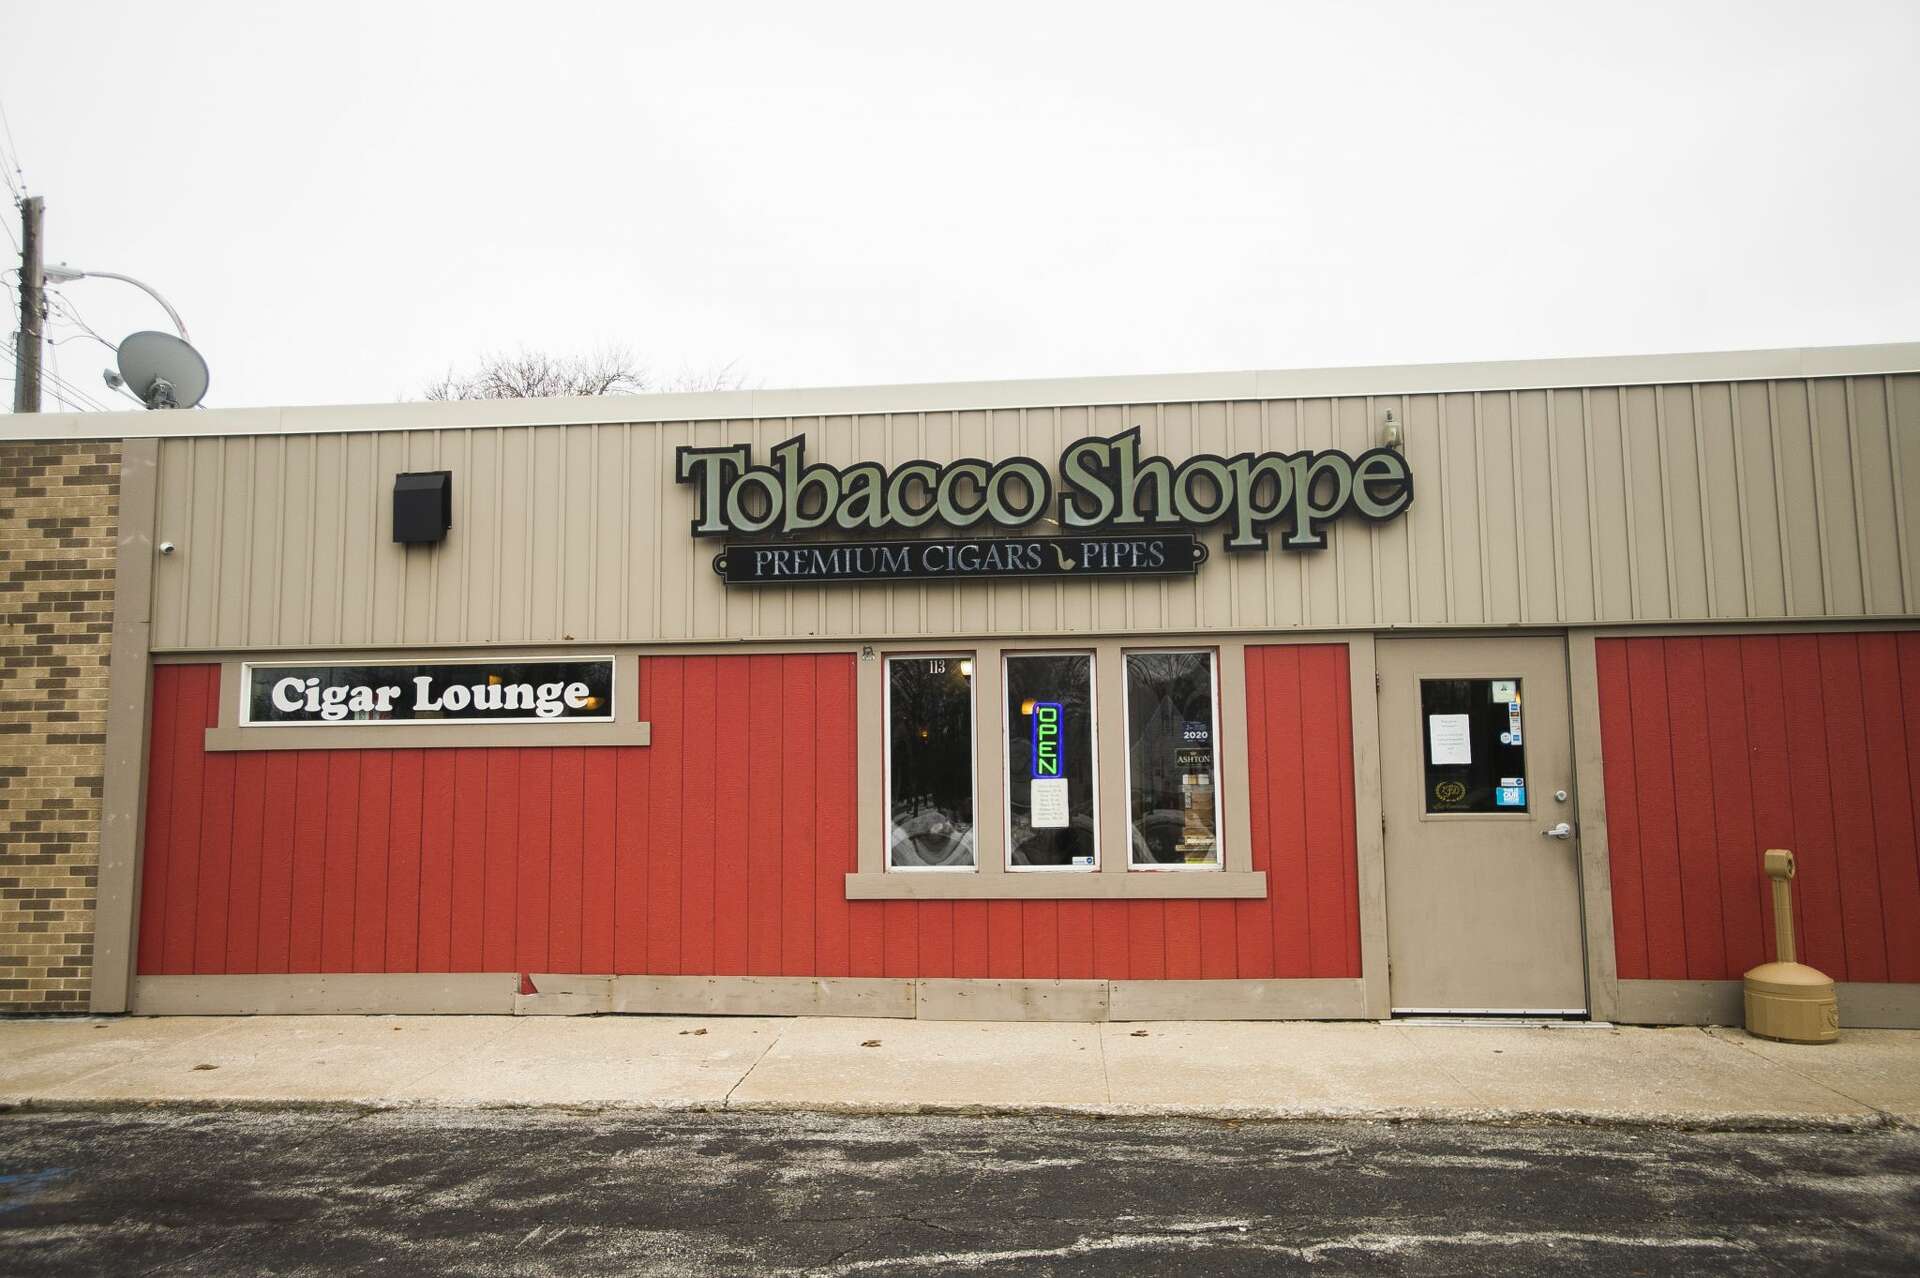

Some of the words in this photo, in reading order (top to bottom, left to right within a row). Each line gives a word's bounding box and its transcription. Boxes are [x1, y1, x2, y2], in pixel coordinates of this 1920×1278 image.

[680, 440, 1048, 534] Tobacco
[1063, 432, 1410, 547] Shoppe
[755, 546, 912, 576] PREMIUM
[922, 543, 1042, 571] CIGARS
[1081, 540, 1165, 568] PIPES
[929, 660, 946, 674] 113
[272, 677, 401, 720] Cigar
[412, 676, 590, 718] Lounge
[1038, 707, 1058, 775] OPEN
[1183, 731, 1208, 739] 2020
[1177, 755, 1211, 764] ASHTON
